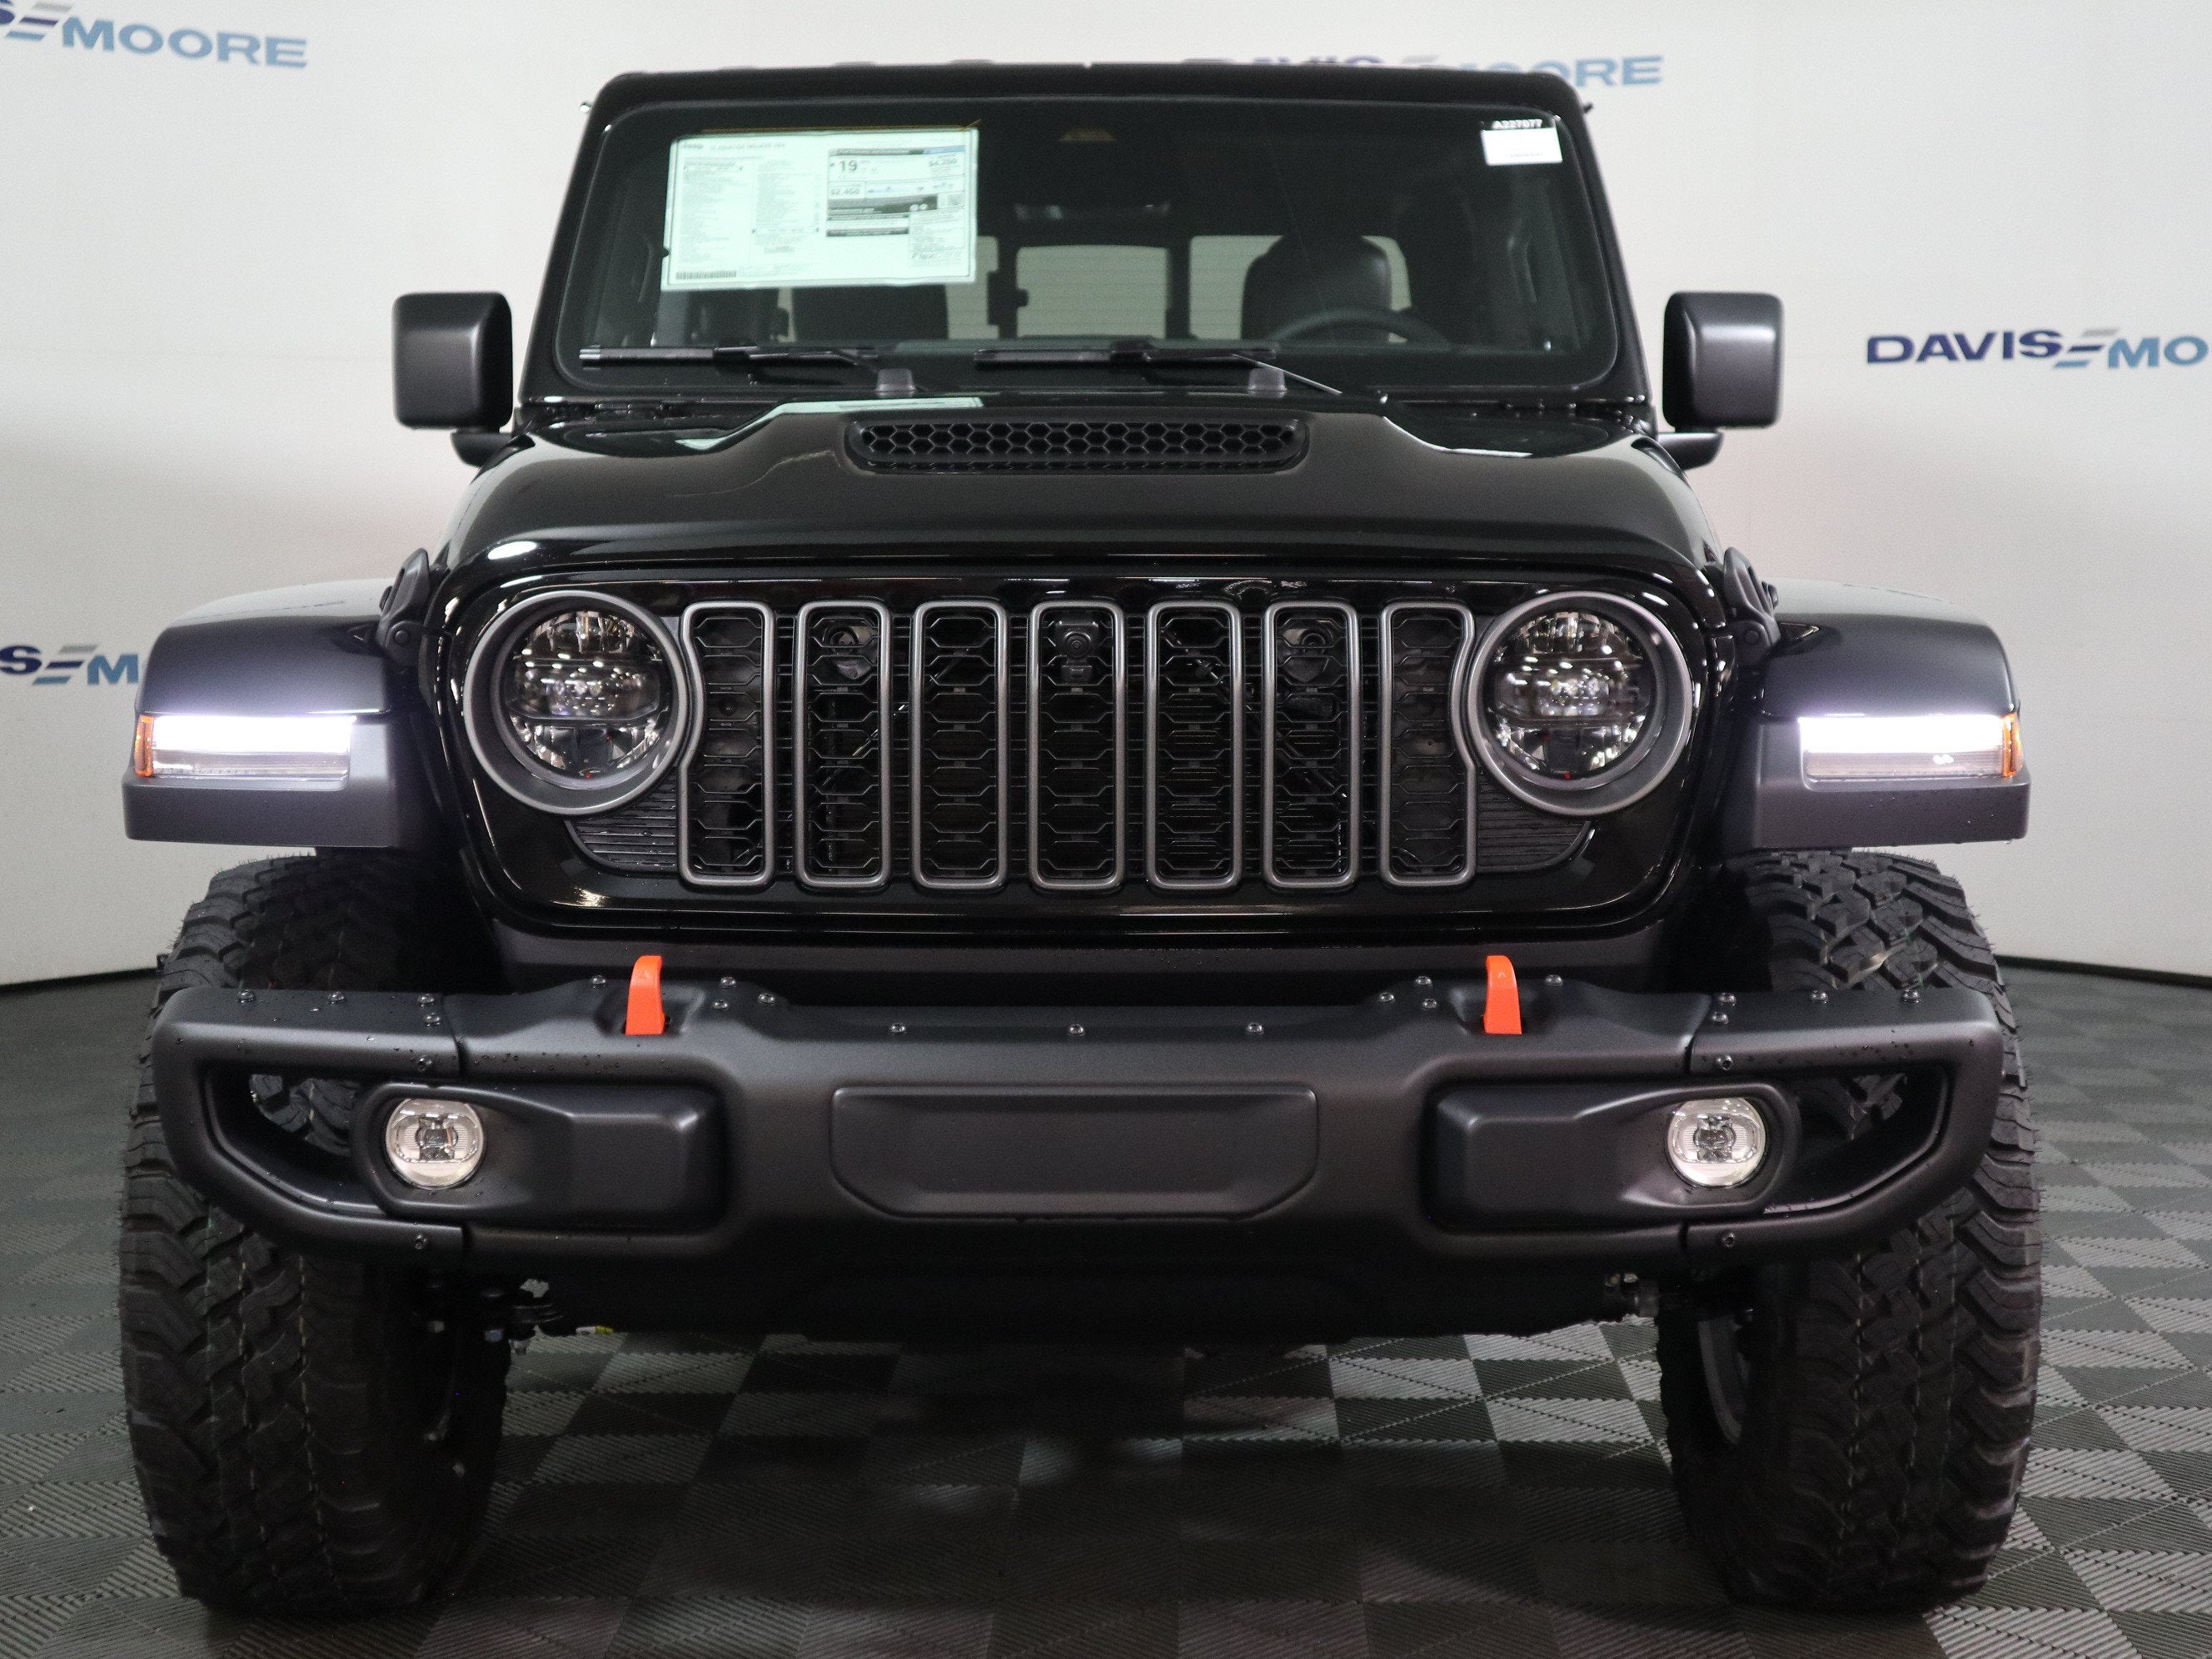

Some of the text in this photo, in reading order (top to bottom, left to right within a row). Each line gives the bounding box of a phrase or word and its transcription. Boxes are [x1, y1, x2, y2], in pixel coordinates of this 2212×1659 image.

[62, 17, 307, 68] MOORE
[839, 160, 858, 172] 19
[1866, 330, 2063, 364] DAVIS
